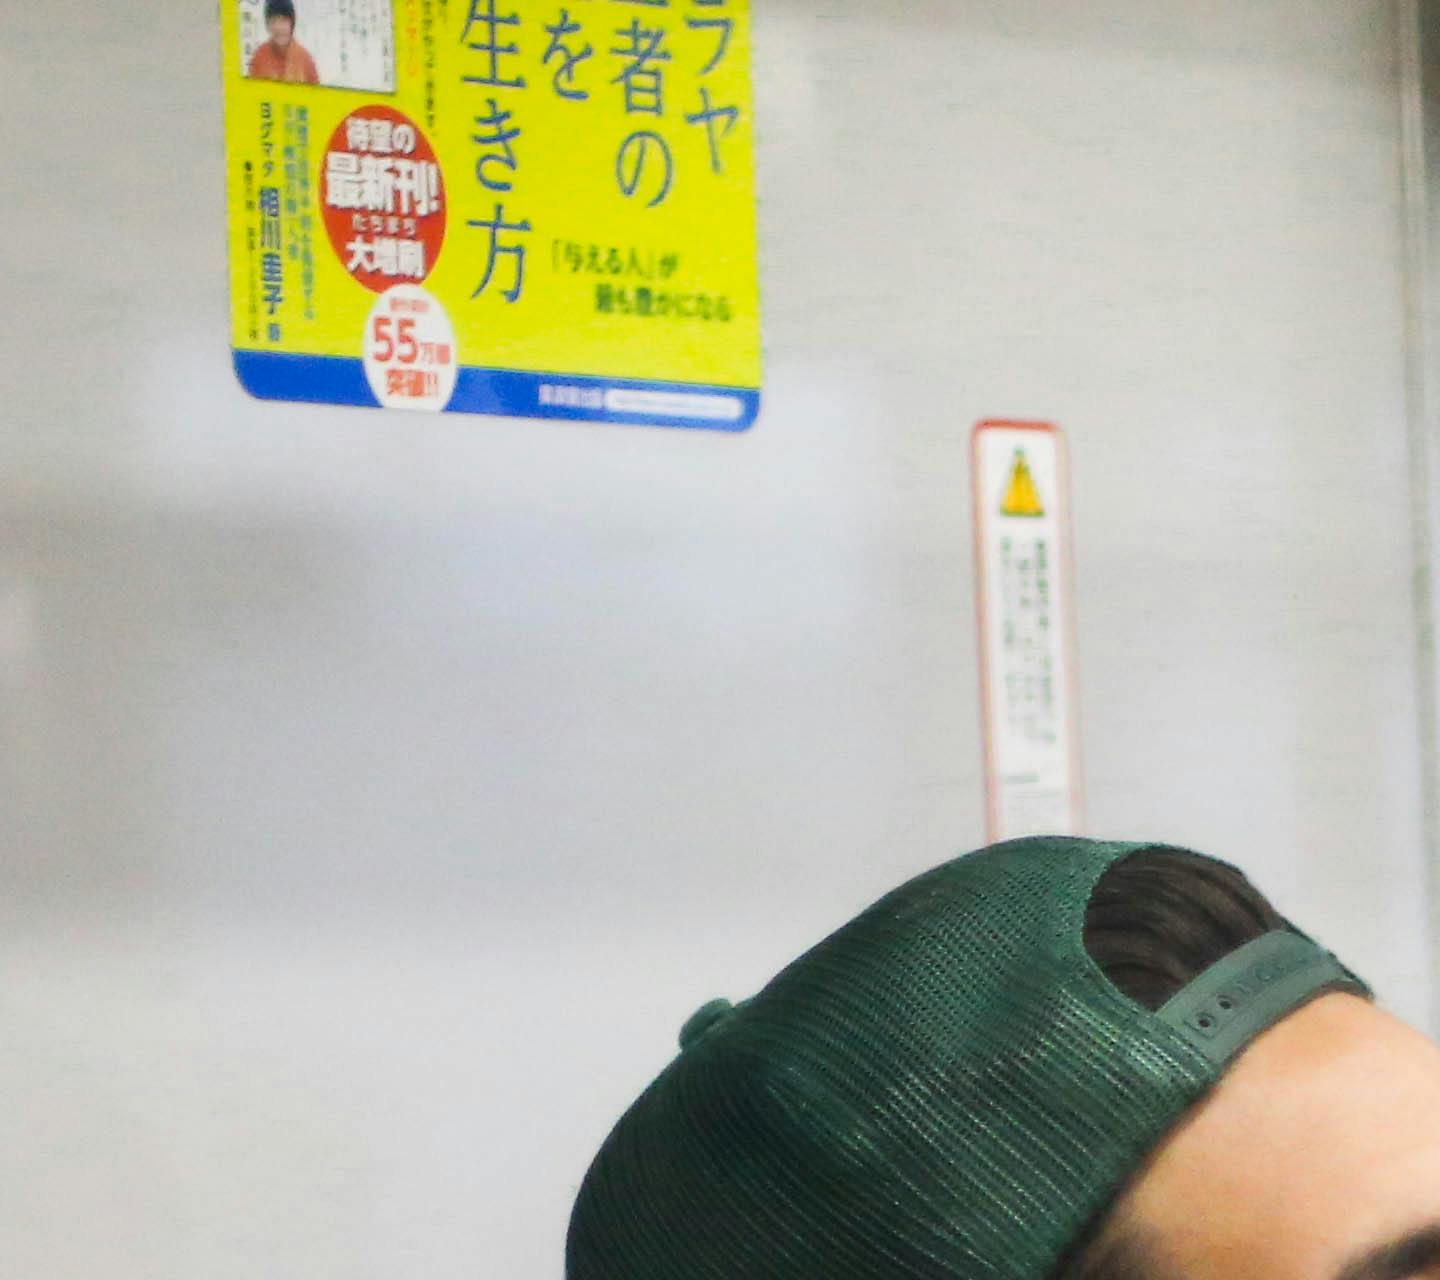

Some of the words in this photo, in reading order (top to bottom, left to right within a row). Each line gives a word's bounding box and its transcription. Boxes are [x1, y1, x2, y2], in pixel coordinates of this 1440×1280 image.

[460, 0, 532, 304] 生き方
[541, 8, 594, 101] を
[610, 0, 674, 208] 者の
